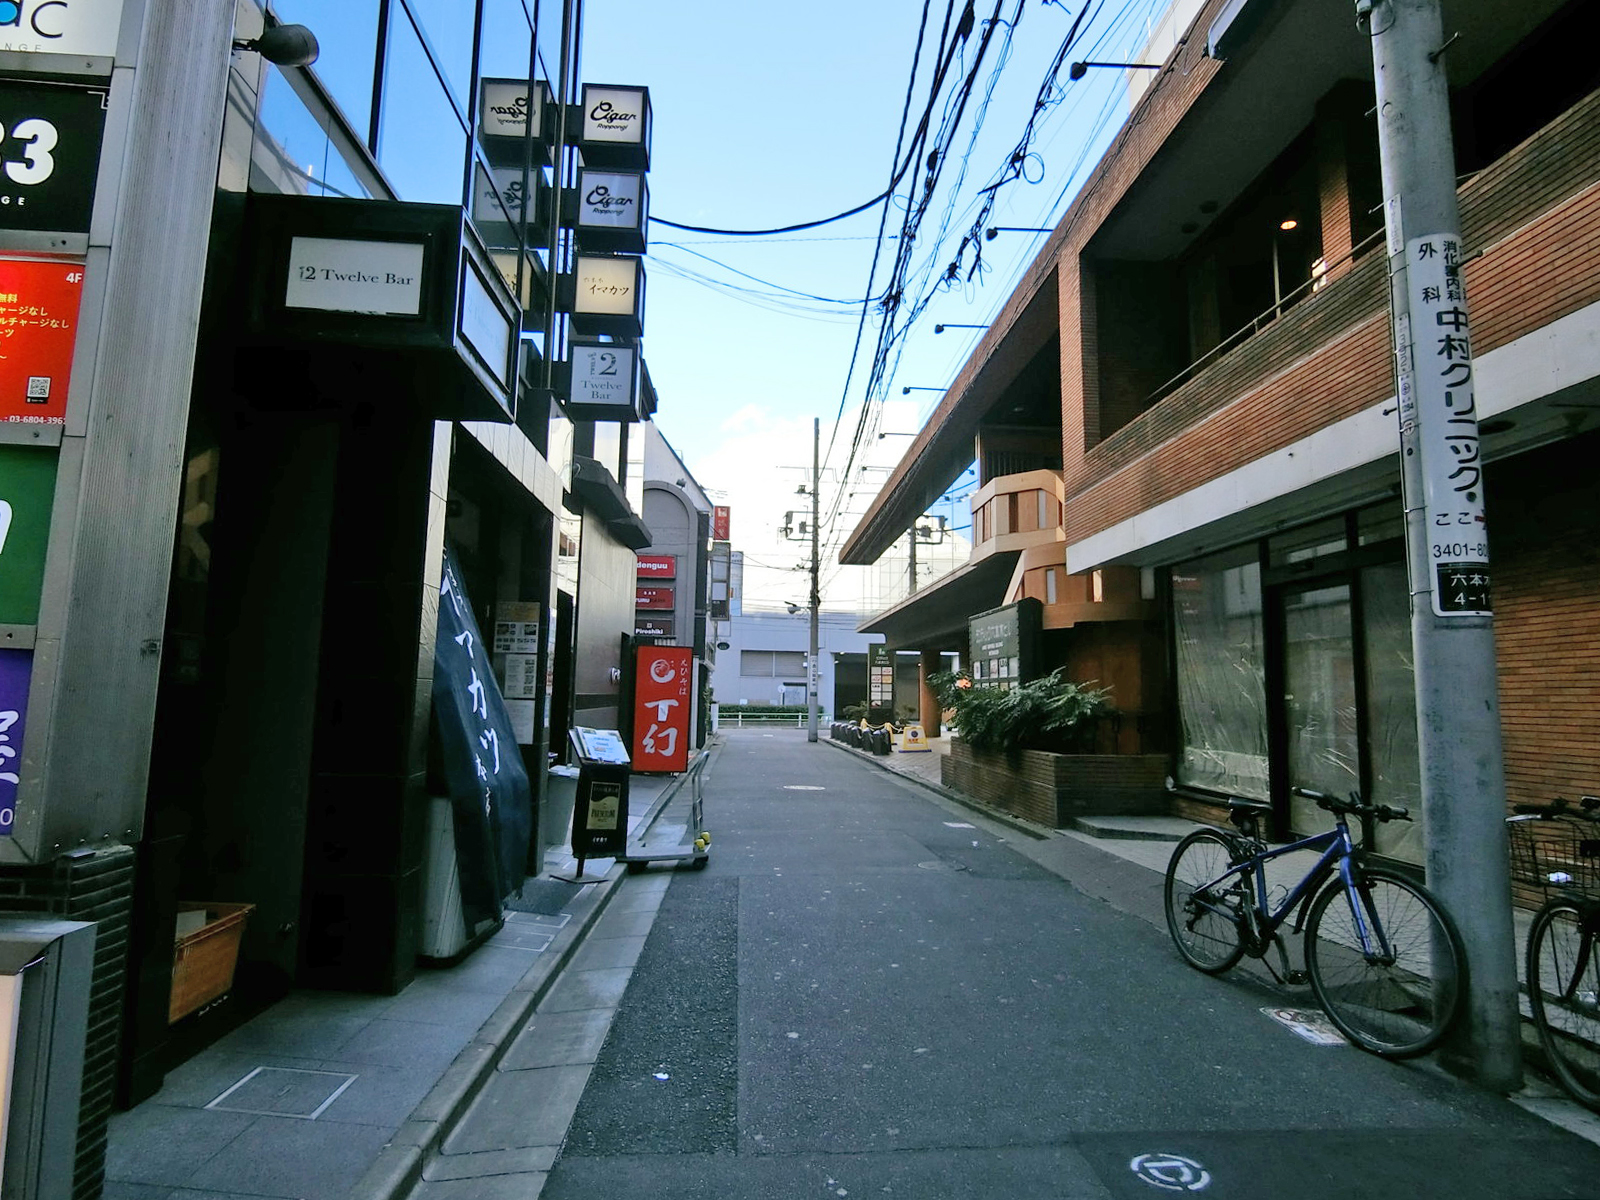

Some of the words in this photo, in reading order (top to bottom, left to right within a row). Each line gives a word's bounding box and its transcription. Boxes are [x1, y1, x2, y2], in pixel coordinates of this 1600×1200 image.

[590, 101, 636, 123] Cigar
[0, 118, 58, 185] 3
[586, 185, 633, 208] Cigar
[66, 273, 82, 283] 4F
[320, 268, 379, 283] Twelve
[385, 272, 414, 285] Bar
[581, 380, 622, 390] Twelve
[591, 391, 611, 399] Bar
[1436, 512, 1472, 526] ここ
